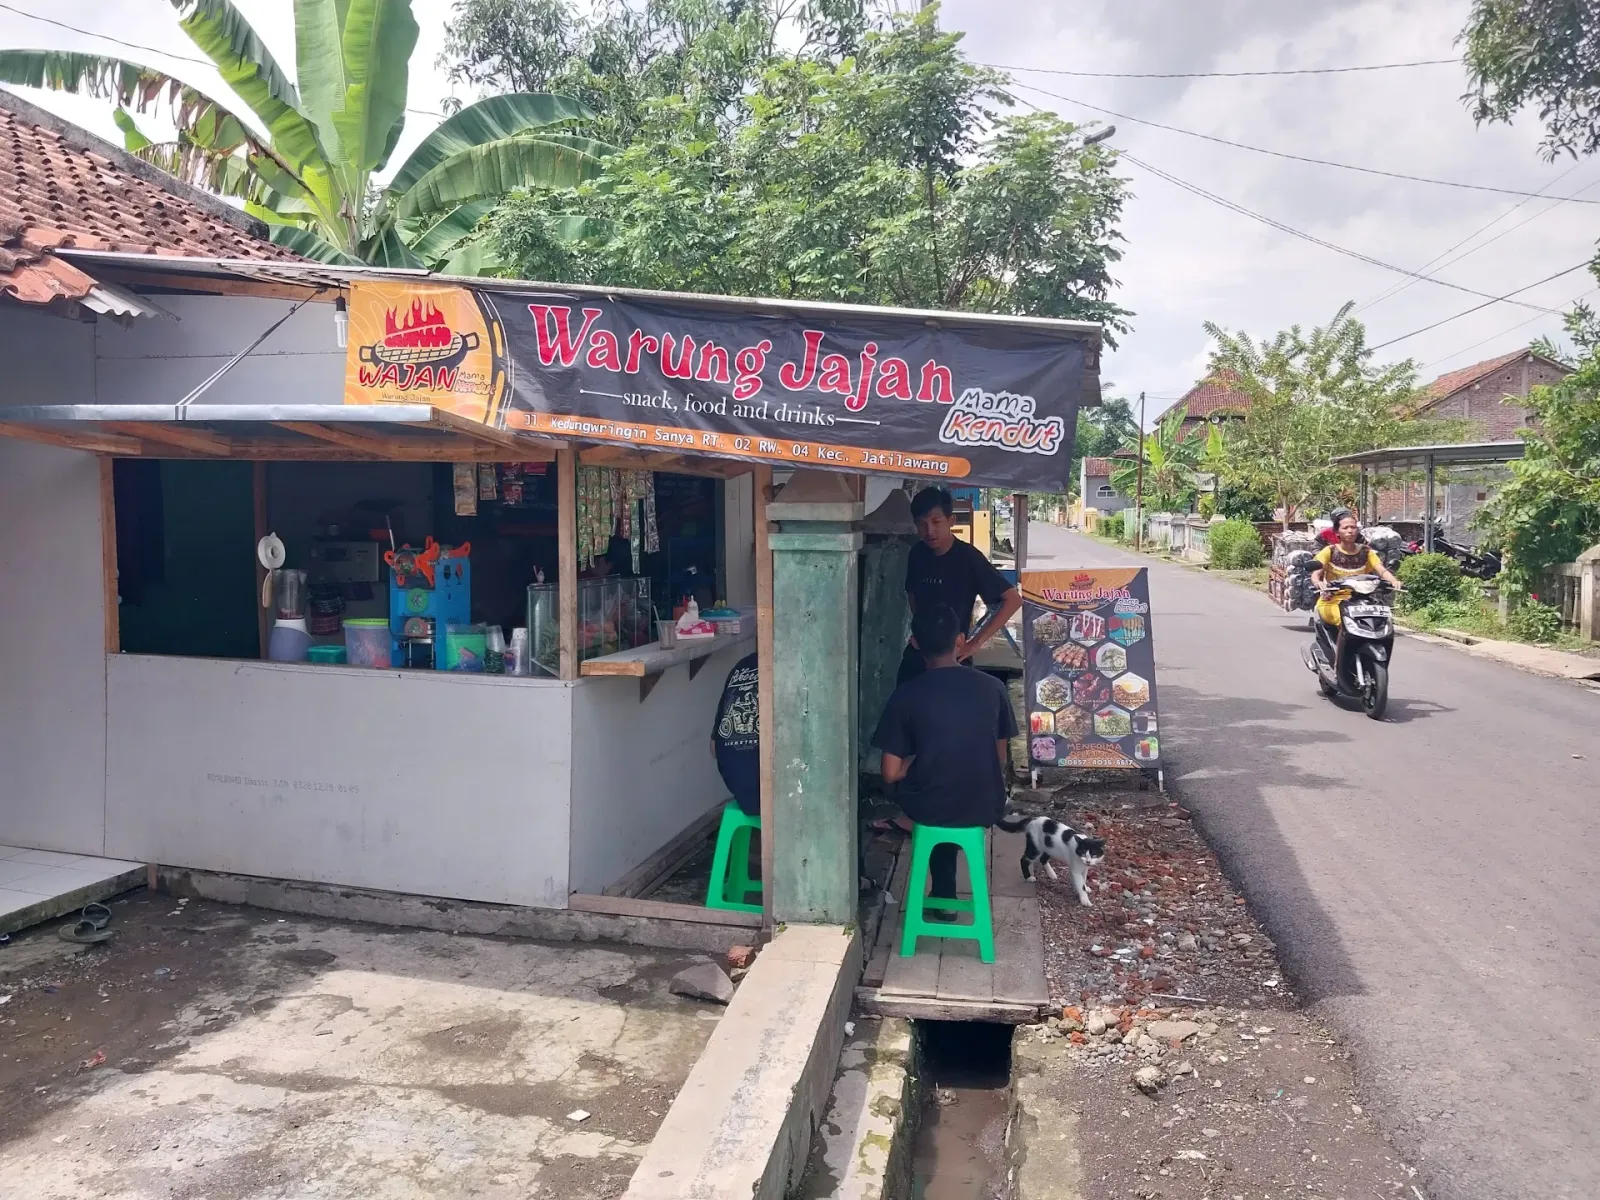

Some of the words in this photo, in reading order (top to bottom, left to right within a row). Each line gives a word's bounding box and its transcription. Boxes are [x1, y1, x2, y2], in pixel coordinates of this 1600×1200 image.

[528, 304, 772, 400] Warung
[779, 330, 954, 412] Jajan
[358, 363, 457, 392] WAJAN
[459, 371, 485, 381] Mama
[622, 390, 678, 413] snack,
[684, 393, 726, 416] food
[733, 402, 767, 420] and
[774, 403, 835, 426] drinks
[957, 389, 1034, 415] Mama
[551, 417, 647, 439] Kedungwringin
[655, 428, 694, 445] Sanya
[703, 434, 725, 448] RT.
[734, 436, 751, 450] 02
[759, 441, 782, 454] RW.
[792, 444, 809, 457] 04
[817, 447, 849, 462] Kec.
[860, 451, 948, 473] Jatilawang
[942, 409, 1062, 452] Kendut
[1042, 588, 1093, 602] Warung
[1095, 587, 1131, 602] Jajan
[1067, 743, 1122, 752] MENERIMA
